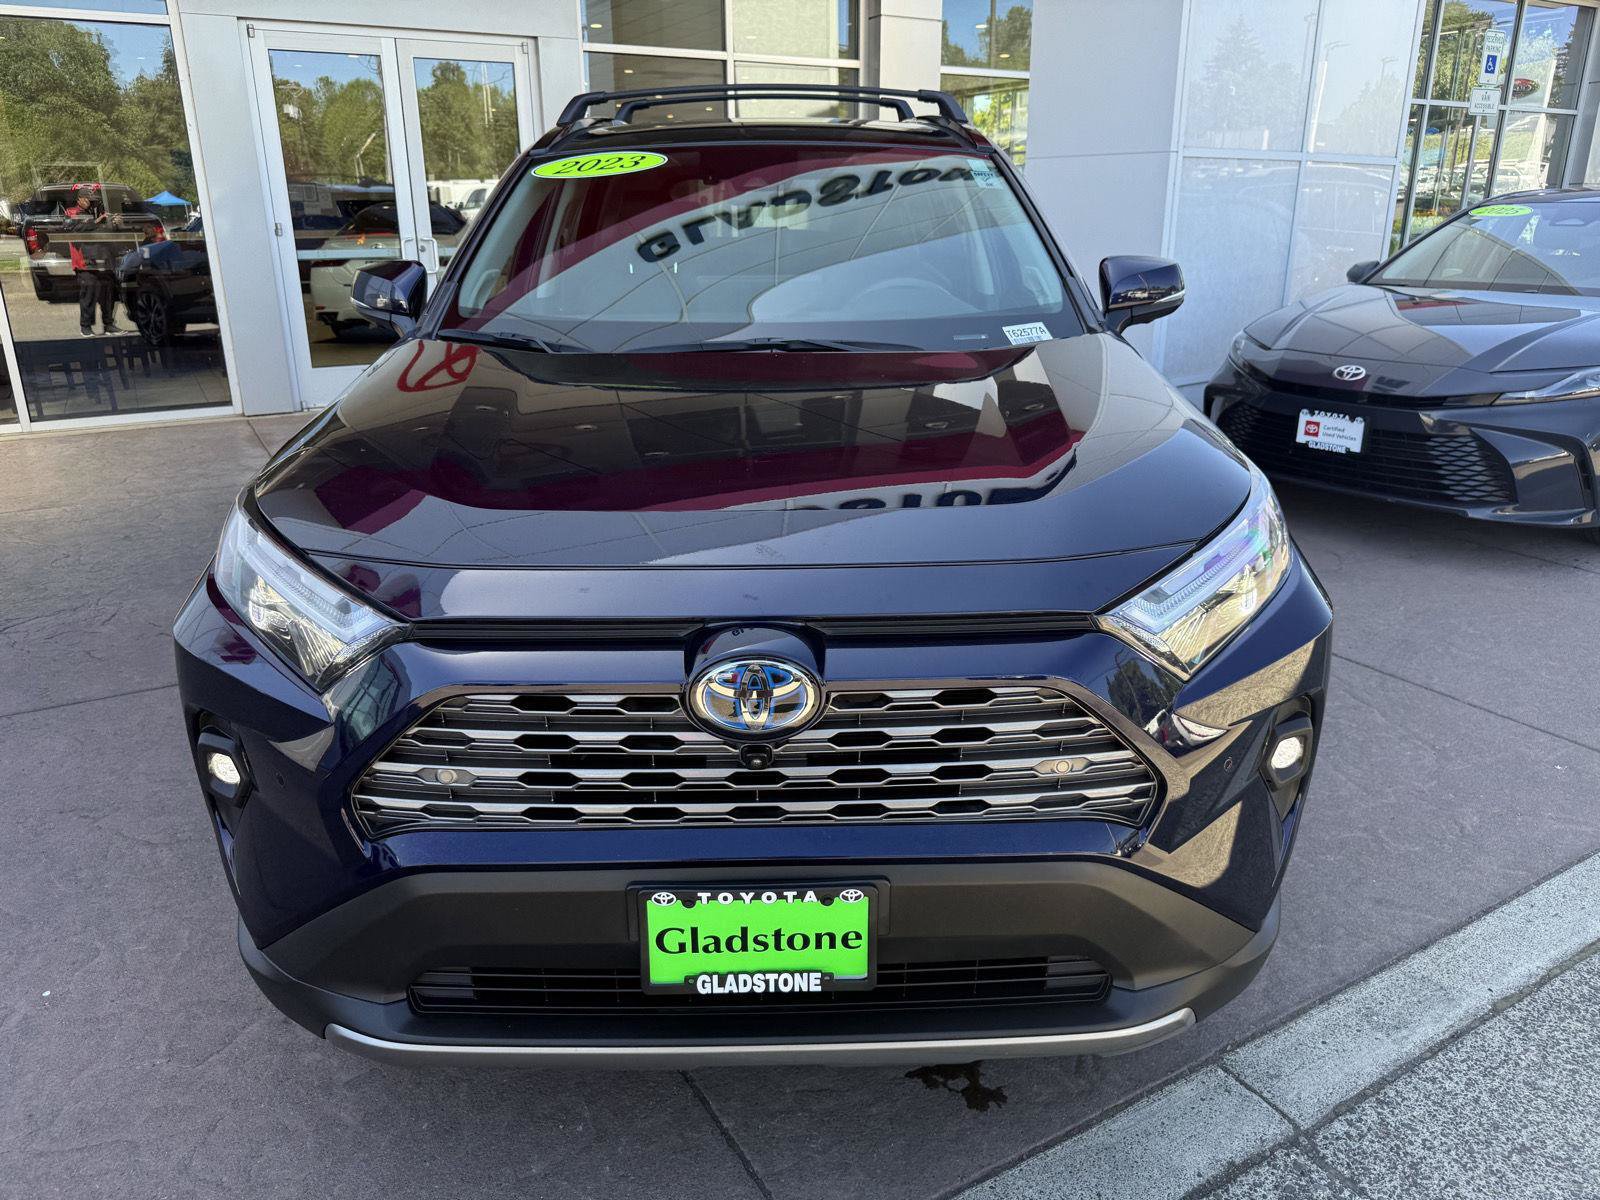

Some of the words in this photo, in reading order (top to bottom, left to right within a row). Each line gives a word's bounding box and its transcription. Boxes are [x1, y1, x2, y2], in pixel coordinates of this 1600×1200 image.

[553, 155, 646, 174] 2023
[1005, 326, 1047, 338] T62577A
[1314, 410, 1350, 421] TOYOTA
[1336, 433, 1356, 441] Vehicles
[1308, 440, 1346, 453] GLADSTONE
[697, 891, 818, 905] TOYOTA
[655, 926, 863, 955] Gladstone
[696, 972, 822, 995] GLADSTONE
